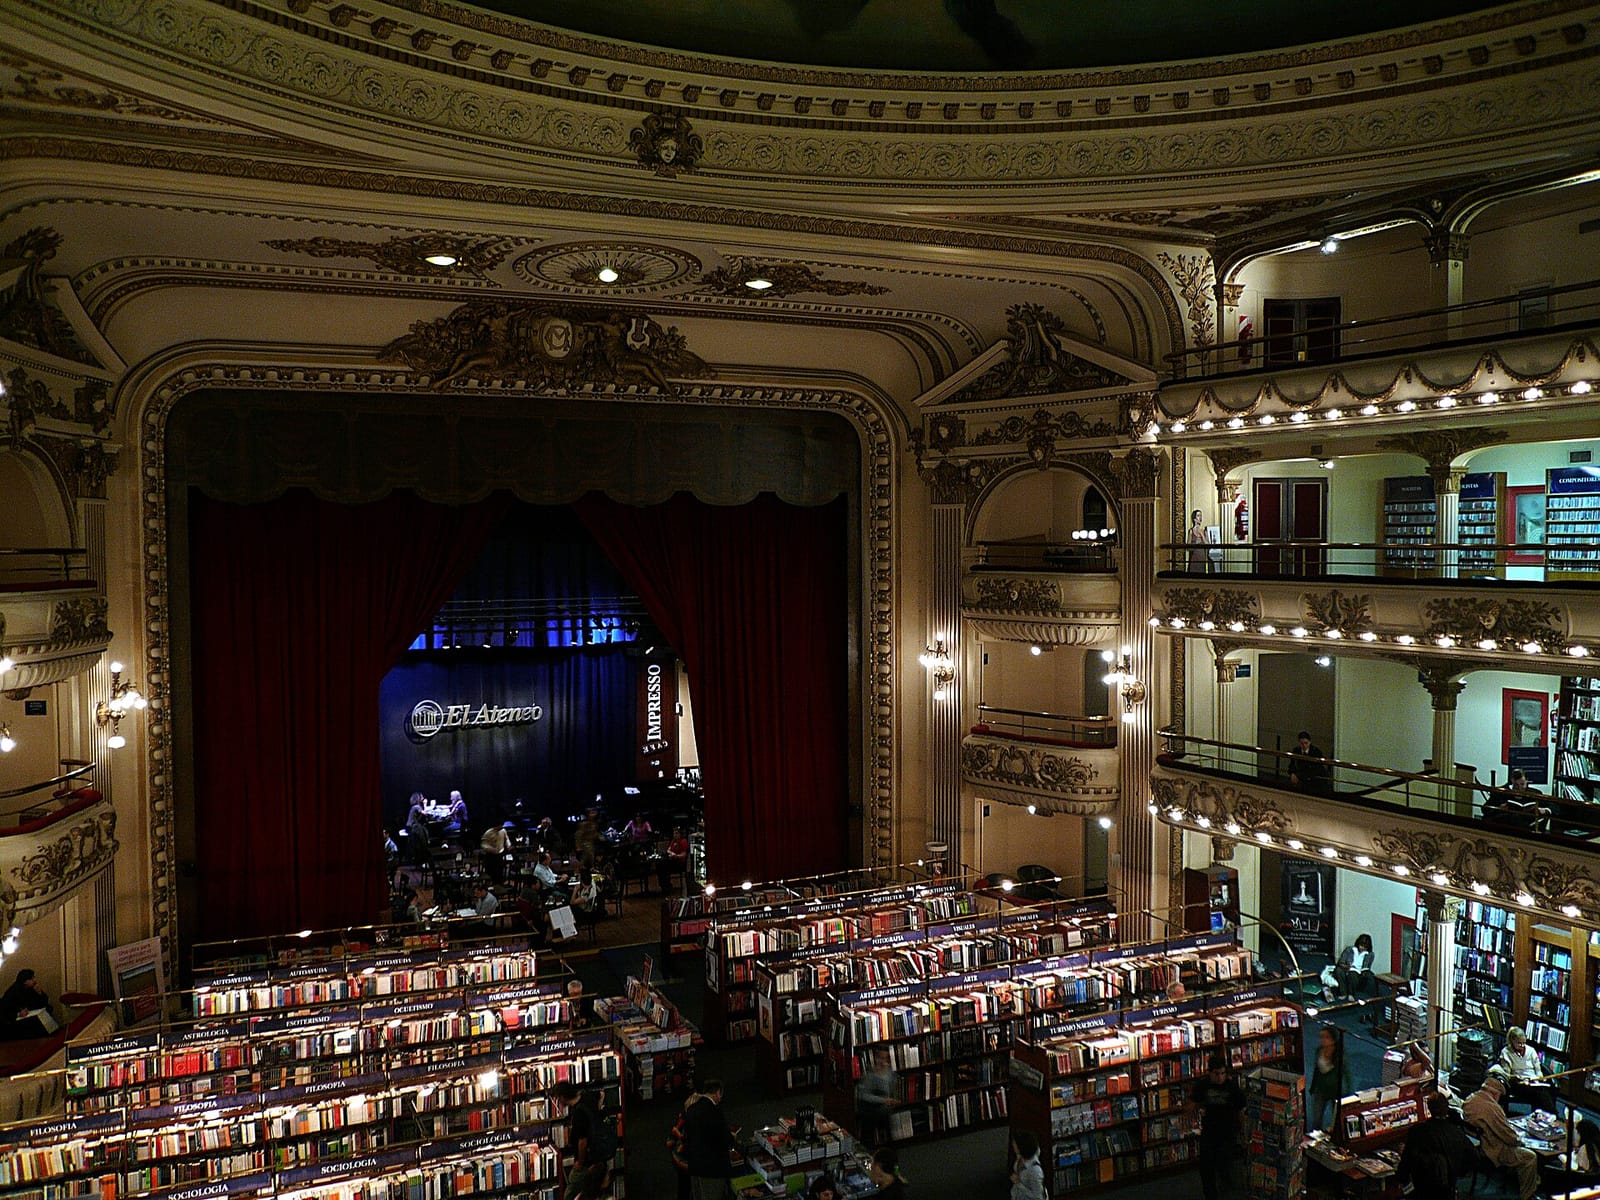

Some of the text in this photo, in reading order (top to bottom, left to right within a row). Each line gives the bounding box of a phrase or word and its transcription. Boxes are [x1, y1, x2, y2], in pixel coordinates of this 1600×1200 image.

[647, 664, 662, 741] IMPRESSO
[443, 703, 543, 727] El Ateneo
[807, 903, 844, 913] ARQUITECTURA
[872, 935, 904, 946] FOTOGRAFIA
[468, 947, 503, 957] AUTOAYUDA
[375, 957, 412, 967] AUTOAYUDA
[1045, 961, 1060, 969] ARTE
[289, 967, 328, 977] AUTOAYUDA
[212, 975, 252, 986] AUTOAYUDA
[963, 975, 978, 983] ARTE
[859, 987, 909, 1000] ARTE ARGENTINO
[1233, 992, 1257, 1001] TURISMO
[393, 1003, 434, 1014] OCULTISMO
[1152, 1006, 1178, 1017] TURISMO
[286, 1016, 330, 1027] ESOTERISMO
[1050, 1019, 1105, 1035] TURISMO NACIONAL
[182, 1028, 229, 1041] ASTROLOGIA
[87, 1040, 138, 1055] ADIVINACION
[540, 1040, 576, 1052] FILOSOFIA
[427, 1060, 465, 1072] FILOSOFIA
[305, 1081, 346, 1093] FILOSOFIA
[173, 1101, 217, 1114] FILOSOFIA
[30, 1122, 77, 1137] FILOSOFIA
[459, 1133, 511, 1149] SOCIOLOGIA
[321, 1158, 377, 1175] SOCIOLOGIA
[168, 1183, 229, 1200] SOCIOLOGIA
